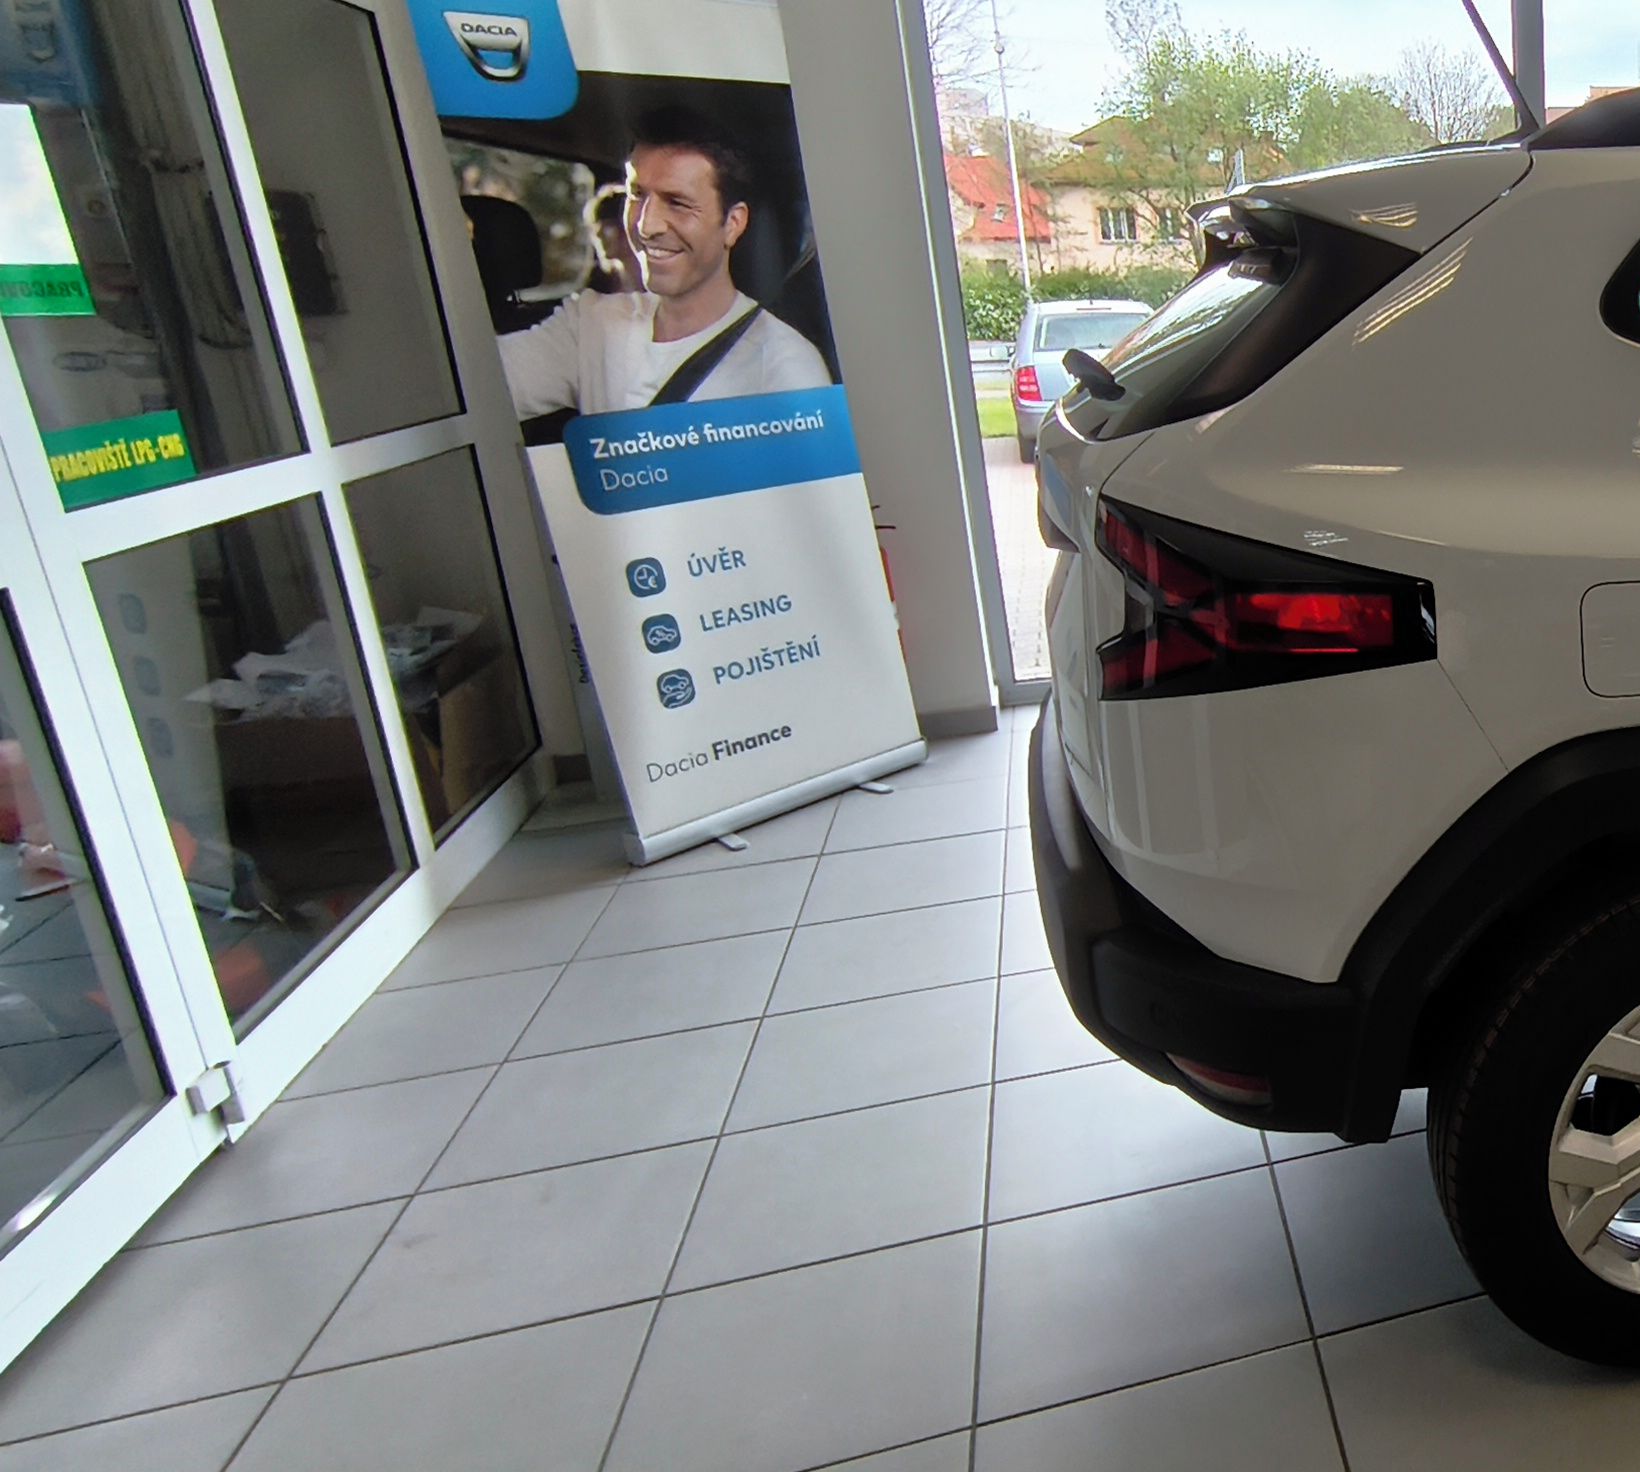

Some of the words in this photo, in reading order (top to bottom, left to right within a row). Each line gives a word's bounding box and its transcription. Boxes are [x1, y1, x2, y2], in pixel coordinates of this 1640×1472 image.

[461, 23, 518, 36] DACIA
[590, 425, 700, 459] Značkové
[704, 409, 825, 443] financování
[50, 438, 131, 483] PRACOVIŠTĚ
[600, 465, 668, 492] Dacia
[687, 546, 746, 577] ÚVĚR
[700, 594, 792, 632] LEASING
[713, 634, 821, 685] POJIŠTĚNÍ
[646, 752, 709, 783] Dacia
[711, 725, 792, 761] Finance
